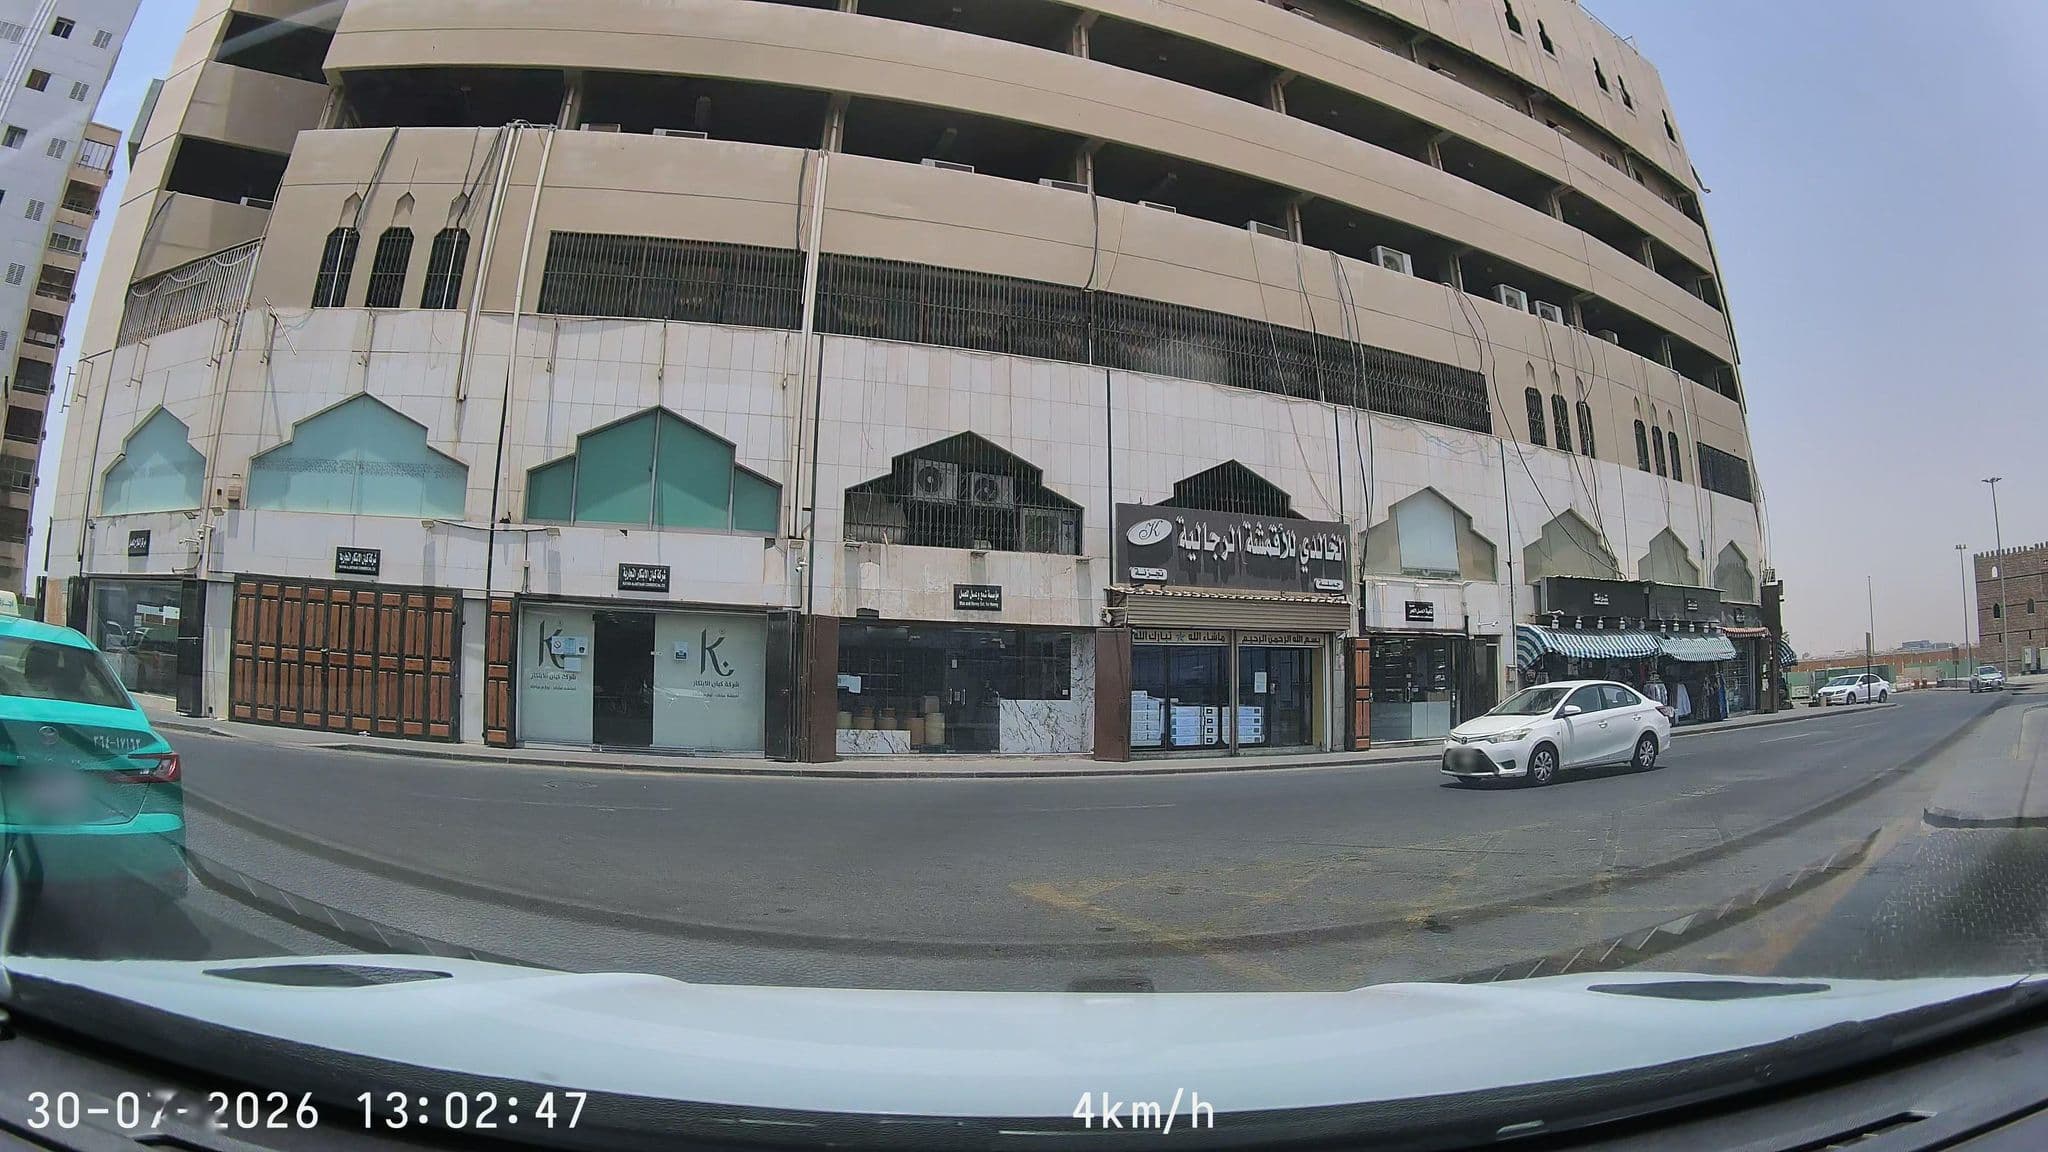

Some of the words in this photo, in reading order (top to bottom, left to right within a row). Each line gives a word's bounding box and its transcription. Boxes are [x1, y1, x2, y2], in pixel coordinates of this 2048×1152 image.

[1176, 515, 1242, 561] الرجالية
[1299, 533, 1347, 574] الخالدي
[1133, 631, 1148, 640] الله
[1149, 631, 1172, 643] تبارك
[1188, 631, 1202, 640] الله
[1242, 634, 1267, 644] الرحيم
[1268, 634, 1292, 643] الرحمن
[1293, 634, 1303, 643] الله
[1304, 636, 1321, 645] بسم
